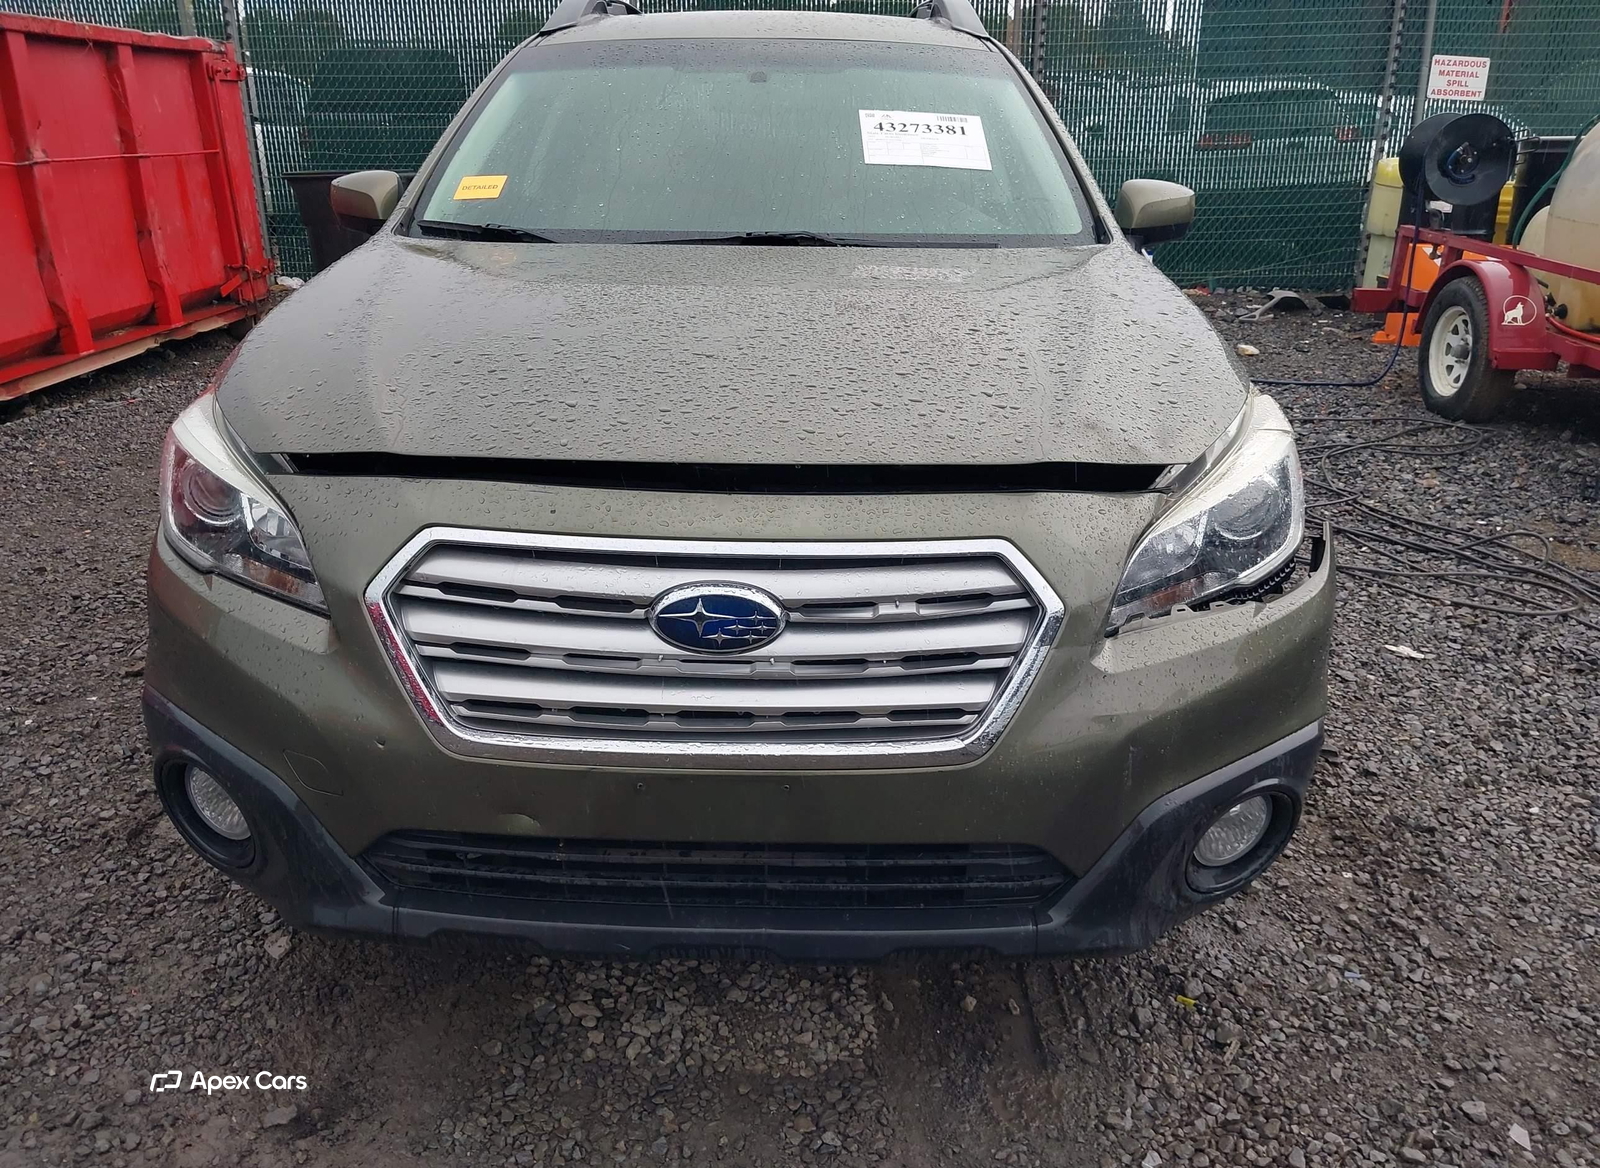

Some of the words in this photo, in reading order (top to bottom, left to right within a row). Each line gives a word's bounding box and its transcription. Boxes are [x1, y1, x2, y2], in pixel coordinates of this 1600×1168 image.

[1434, 59, 1487, 68] HAZARDOUS
[1438, 70, 1480, 78] MATERIAL
[1446, 79, 1469, 87] SPILL
[1431, 89, 1482, 97] ABSORBENT
[873, 122, 968, 136] 43273381
